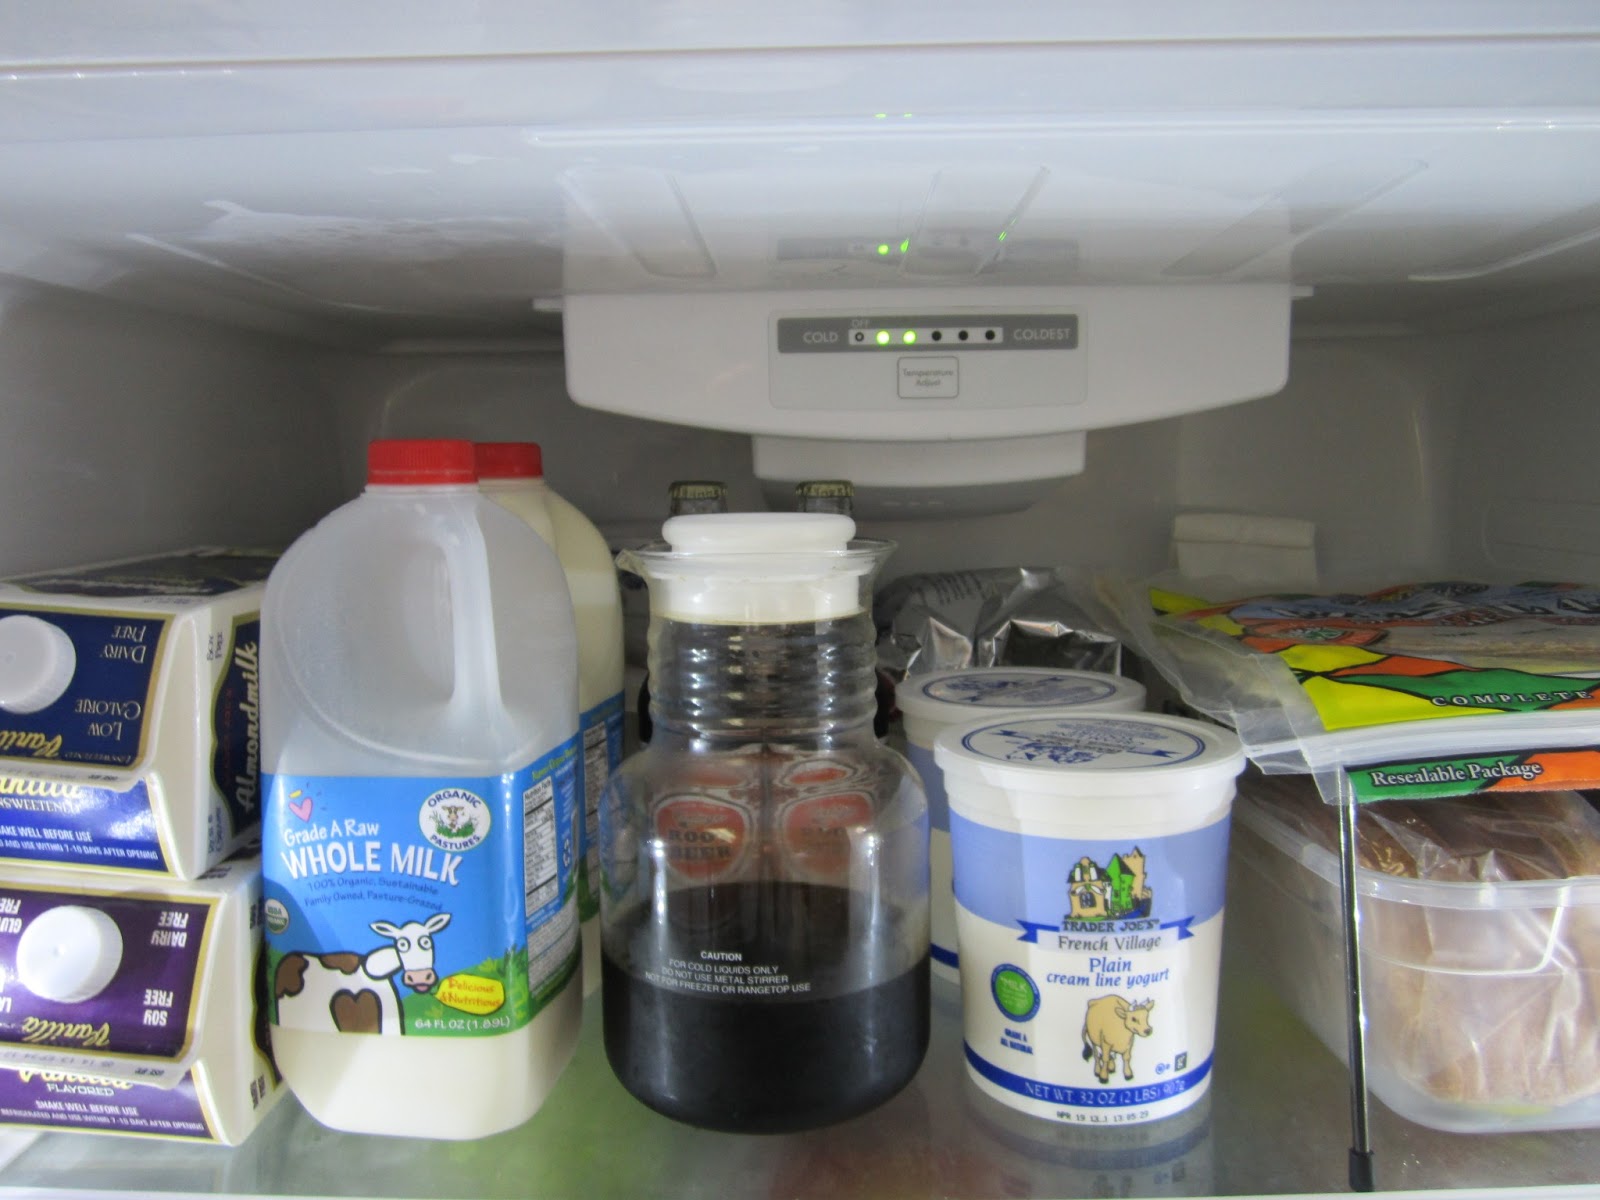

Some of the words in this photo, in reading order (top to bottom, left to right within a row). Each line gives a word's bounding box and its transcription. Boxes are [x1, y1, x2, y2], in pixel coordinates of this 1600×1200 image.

[803, 331, 838, 344] COLD
[1012, 327, 1072, 342] COLDEST
[902, 368, 954, 379] Temperature
[112, 624, 147, 643] FREE
[101, 644, 147, 664] DAIRY
[1431, 690, 1594, 706] COMPLETE
[75, 698, 142, 720] CALORIE
[88, 721, 123, 742] LOW
[235, 639, 260, 812] Almondmilk
[1371, 767, 1466, 786] Resealable
[1467, 761, 1543, 780] Package
[428, 788, 482, 808] ORGANIC
[17, 826, 42, 838] WELL
[43, 828, 75, 841] BEFORE
[75, 831, 93, 842] USE
[284, 822, 328, 847] Grade
[330, 821, 342, 838] A
[344, 819, 380, 837] Raw
[36, 842, 63, 852] WITHIN
[83, 846, 102, 856] DAYS
[103, 847, 126, 858] AFTER
[126, 849, 159, 861] OPENING
[429, 834, 481, 851] PASTURES
[280, 841, 381, 880] WHOLE
[391, 843, 464, 887] MILK
[307, 878, 335, 893] 100%
[378, 877, 440, 896] Sustainable
[304, 890, 333, 908] Family
[158, 911, 190, 929] FREE
[1062, 920, 1115, 933] TRADER
[151, 931, 188, 948] DAIRY
[1058, 935, 1109, 951] French
[1115, 935, 1161, 951] Village
[700, 950, 743, 962] CAUTION
[669, 959, 687, 969] FOR
[687, 962, 712, 973] COLD
[713, 964, 751, 974] LIQUIDS
[753, 965, 779, 976] ONLY
[1089, 957, 1132, 974] Plain
[447, 976, 496, 993] Delicious
[645, 971, 661, 984] NOT
[661, 976, 679, 987] FOR
[679, 980, 720, 993] FREEZER
[721, 982, 736, 993] OR
[737, 984, 790, 995] RANGETOP
[791, 982, 811, 993] USE
[661, 966, 674, 976] DO
[675, 969, 692, 980] NOT
[694, 973, 713, 983] USE
[714, 974, 745, 985] METAL
[746, 974, 789, 985] STIRRER
[1046, 972, 1090, 988] cream
[1095, 972, 1121, 987] line
[1127, 968, 1170, 989] yogurt
[144, 989, 174, 1008] FREE
[143, 1009, 168, 1026] SOY
[415, 1018, 434, 1030] 64
[435, 1018, 449, 1030] FL
[449, 1018, 465, 1030] OZ
[22, 1016, 110, 1046] Vanilla
[46, 1083, 114, 1097] FLAVORED
[1025, 1081, 1051, 1099] NET
[1079, 1091, 1094, 1104] 32
[1098, 1092, 1116, 1105] OZ
[35, 1100, 64, 1112] SHAKE
[64, 1102, 89, 1113] WELL
[89, 1103, 121, 1115] BEFORE
[121, 1106, 139, 1117] USE
[51, 1112, 68, 1121] AND
[149, 1120, 172, 1130] AFTER
[172, 1121, 205, 1132] OPENING
